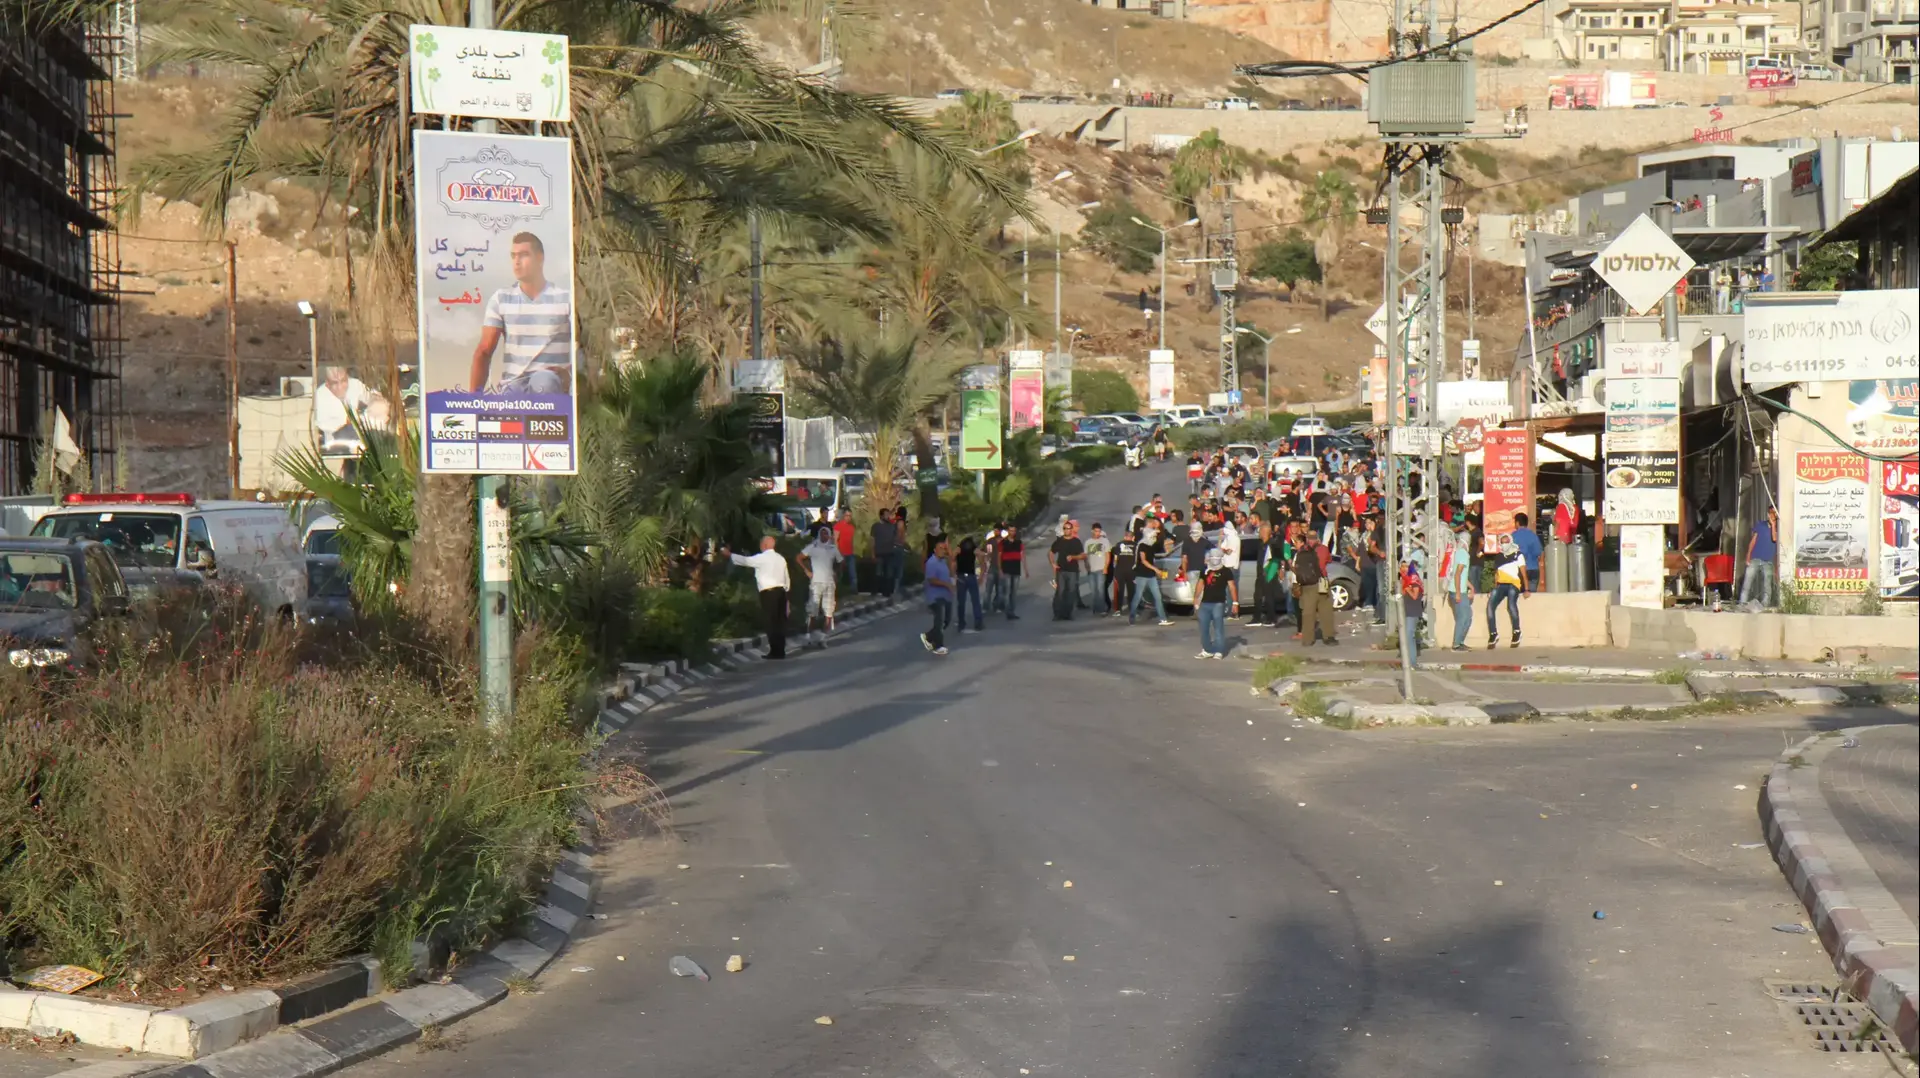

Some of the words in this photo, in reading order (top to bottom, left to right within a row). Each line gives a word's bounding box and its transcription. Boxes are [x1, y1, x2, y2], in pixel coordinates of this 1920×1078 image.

[455, 45, 489, 64] بلدي
[493, 44, 526, 63] أحب
[472, 65, 512, 84] نظيفة
[459, 97, 481, 108] الفحم
[447, 181, 541, 206] OLYMPIA
[428, 238, 449, 254] كل
[454, 239, 490, 257] ليس
[435, 259, 466, 280] يلمع
[471, 259, 484, 273] ما
[1603, 252, 1681, 275] אלסולטן
[438, 287, 482, 311] ذهب
[1749, 358, 1846, 373] 04-6111195
[1885, 355, 1919, 368] 04-6
[445, 399, 555, 412] www.Olympia100.com
[530, 420, 564, 432] BOSS
[431, 430, 476, 440] LACOSTE
[434, 448, 475, 456] GANT
[1637, 456, 1654, 467] فول
[1801, 455, 1833, 465] חילוף
[1836, 454, 1864, 466] חלקי
[1640, 469, 1652, 477] פול
[1801, 468, 1837, 477] דעדוש
[1842, 468, 1864, 477] וגרר
[1833, 488, 1847, 497] غيار
[1849, 488, 1864, 499] قطع
[1841, 522, 1852, 530] לכל
[1799, 569, 1862, 578] 04-6113737
[1797, 579, 1864, 591] 057-7414515
